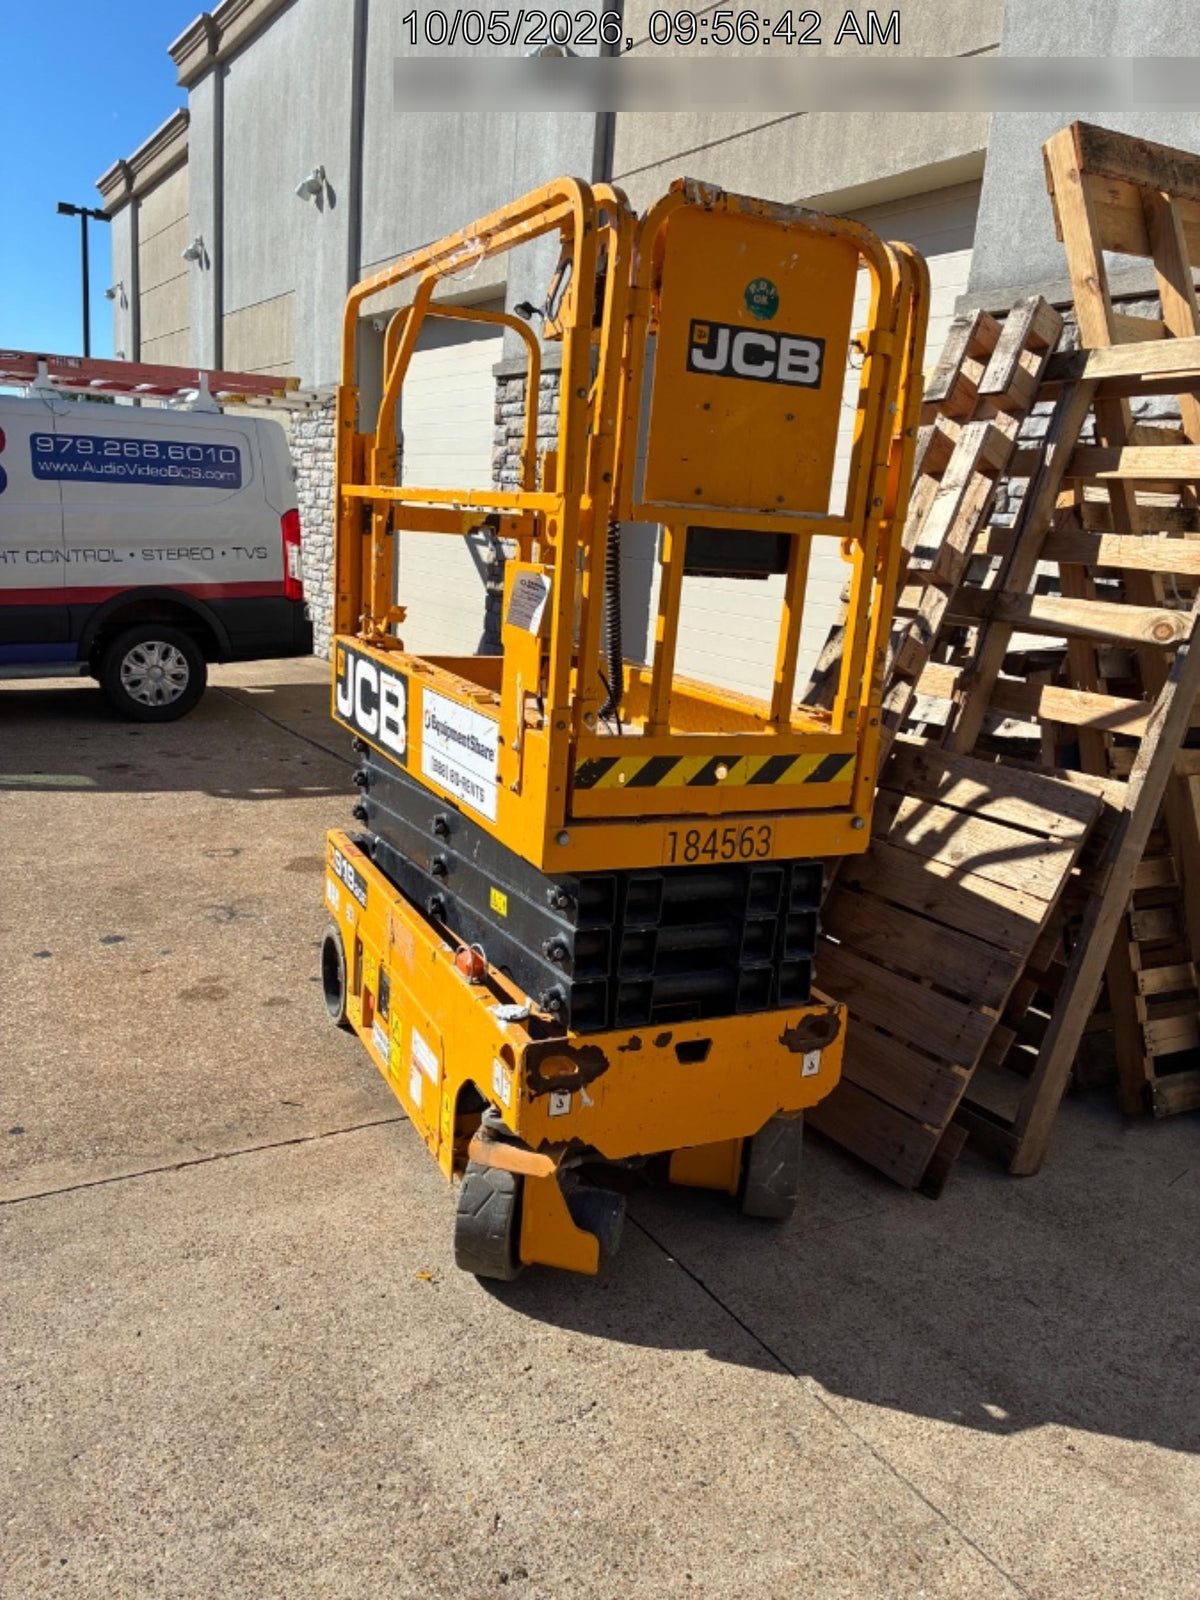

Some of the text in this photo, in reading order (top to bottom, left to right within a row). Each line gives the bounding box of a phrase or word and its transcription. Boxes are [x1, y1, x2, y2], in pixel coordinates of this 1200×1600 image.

[690, 327, 821, 384] JCB
[35, 436, 236, 464] 979.268.6010
[38, 460, 237, 481] www.AudioVideoBCS.com
[26, 549, 123, 564] CONTROL
[142, 547, 214, 561] STEREO
[231, 546, 268, 560] TVS
[337, 652, 407, 755] JCB
[431, 713, 496, 763] EquipmentShare
[668, 824, 772, 863] 184563
